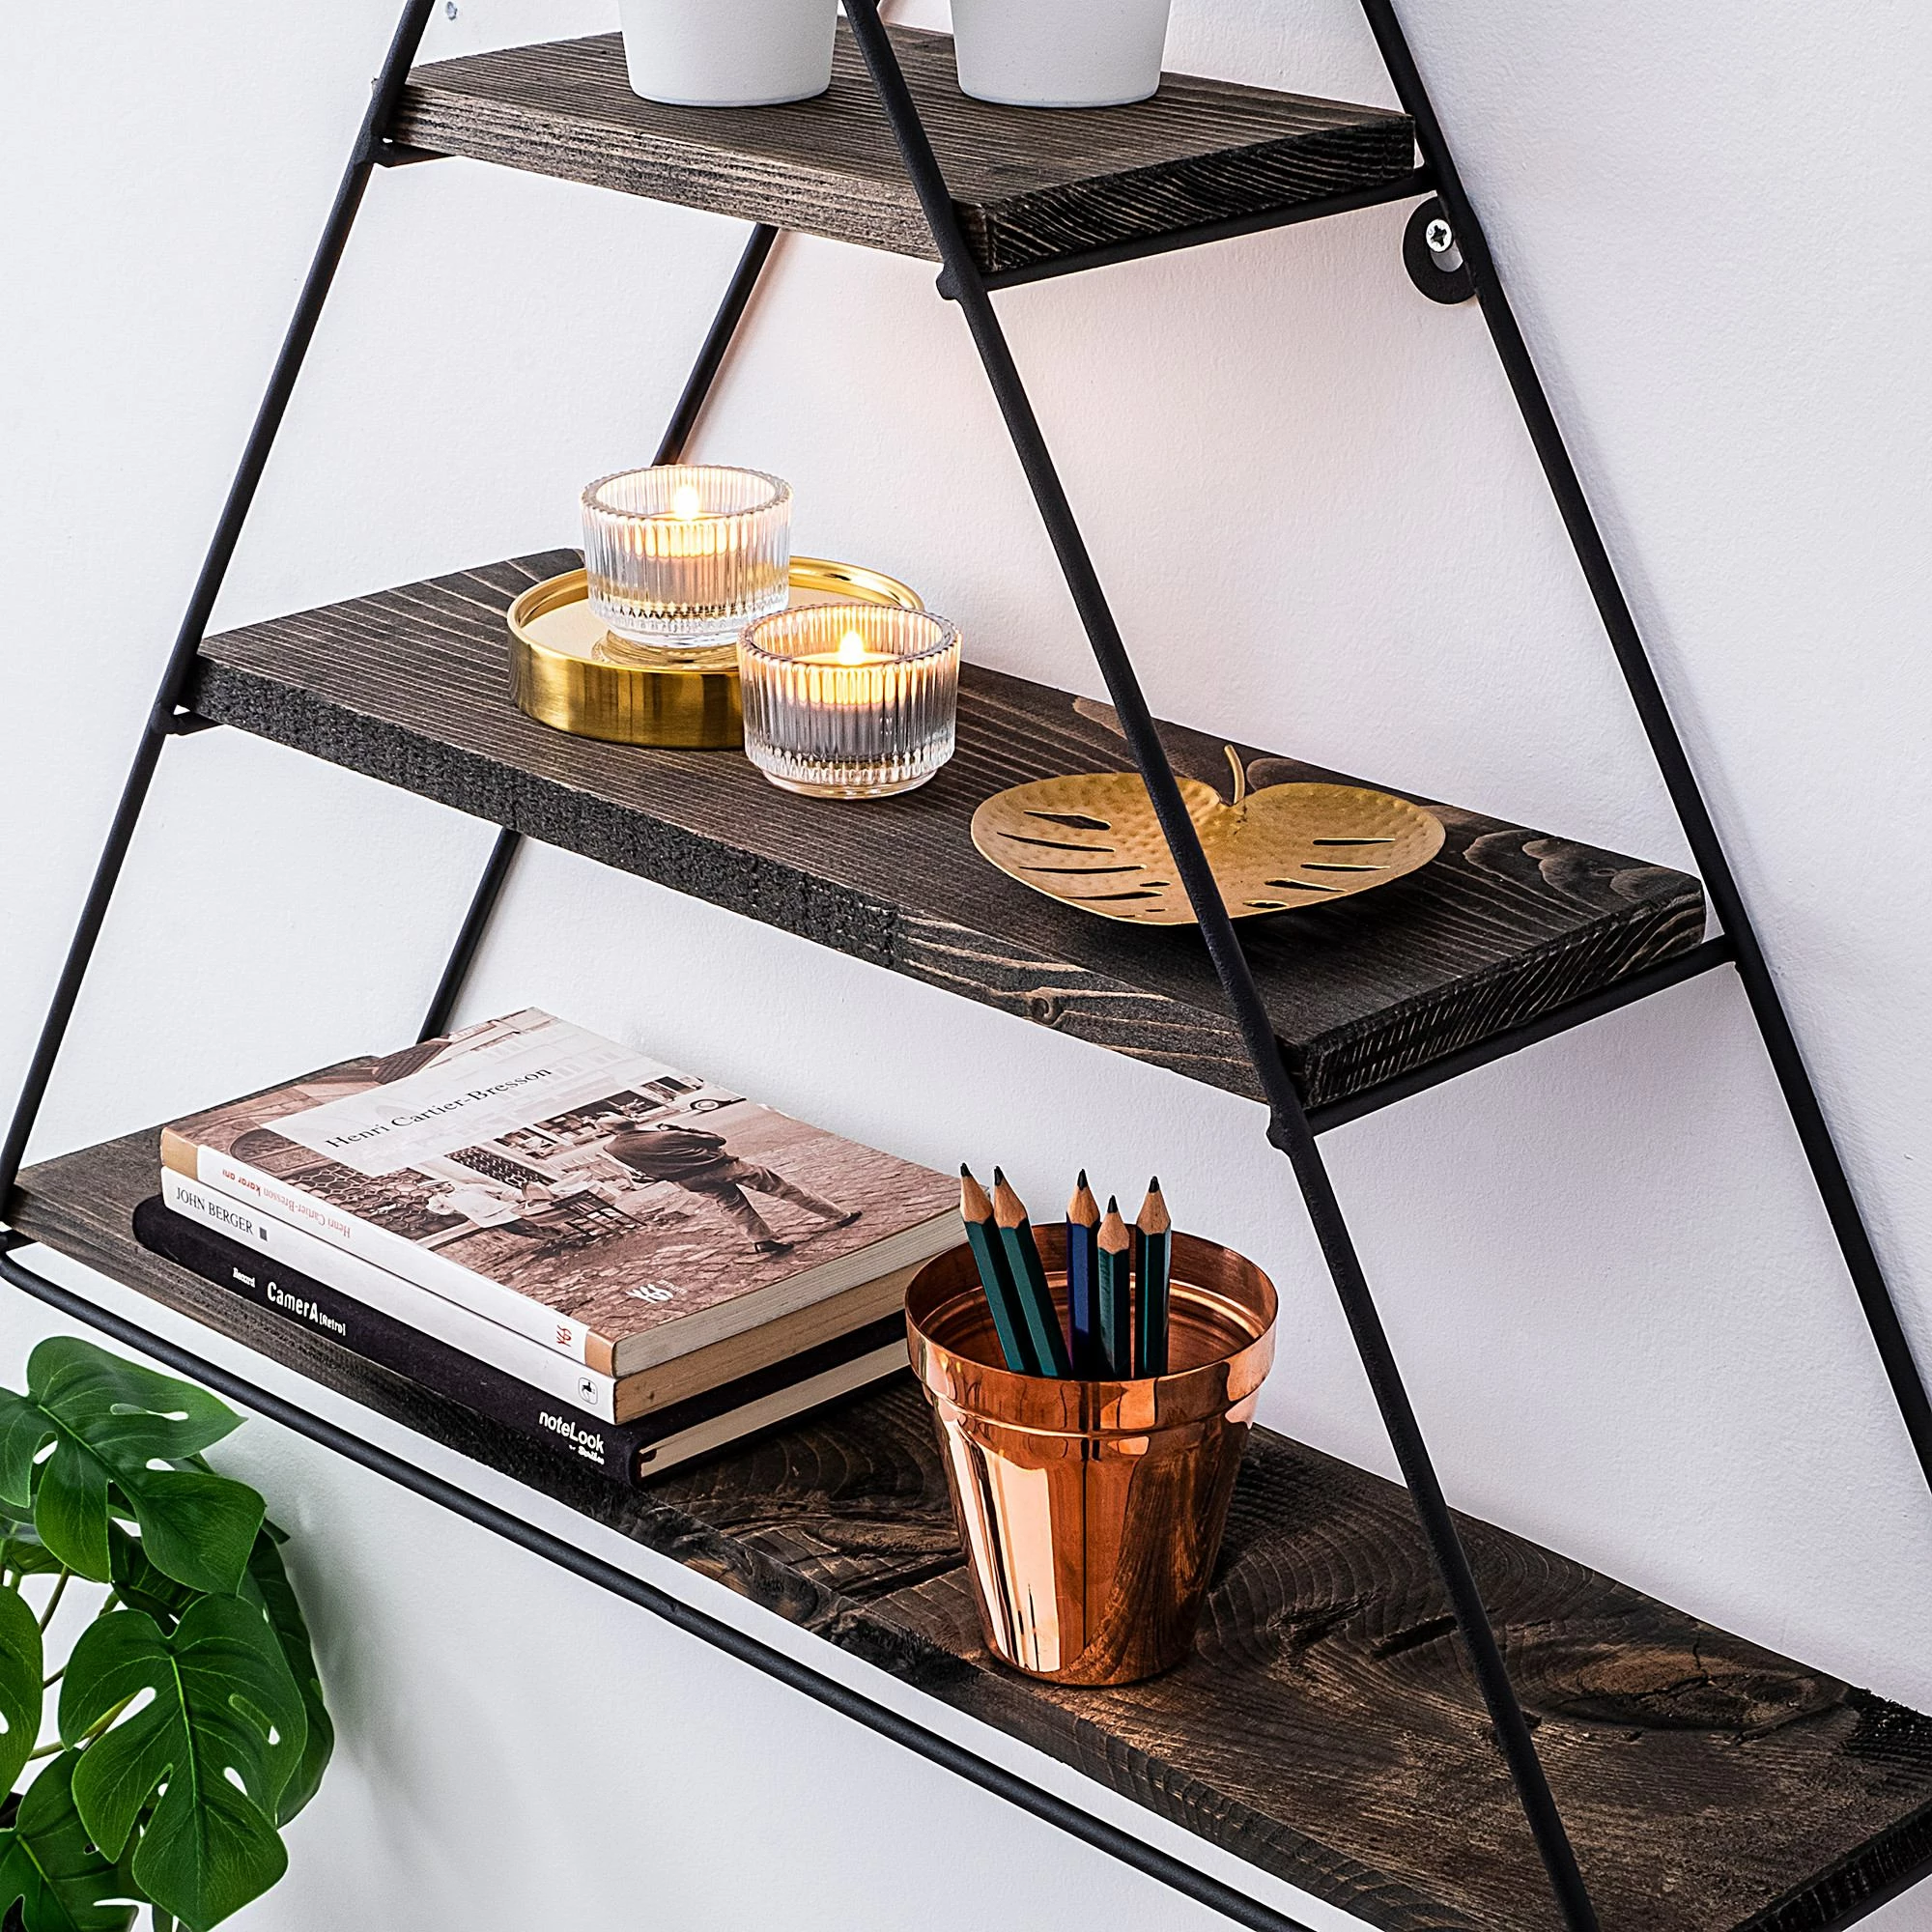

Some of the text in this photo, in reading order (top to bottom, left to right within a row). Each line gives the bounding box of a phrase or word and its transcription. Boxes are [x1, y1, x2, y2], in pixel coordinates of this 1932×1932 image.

[326, 1067, 552, 1149] Henri Cartier-Bresson
[238, 1176, 261, 1197] karar
[176, 1187, 254, 1236] JOHN BERGER
[262, 1189, 327, 1226] Cartier-Bresson
[327, 1217, 351, 1238] Henri
[539, 1411, 605, 1454] noteLook
